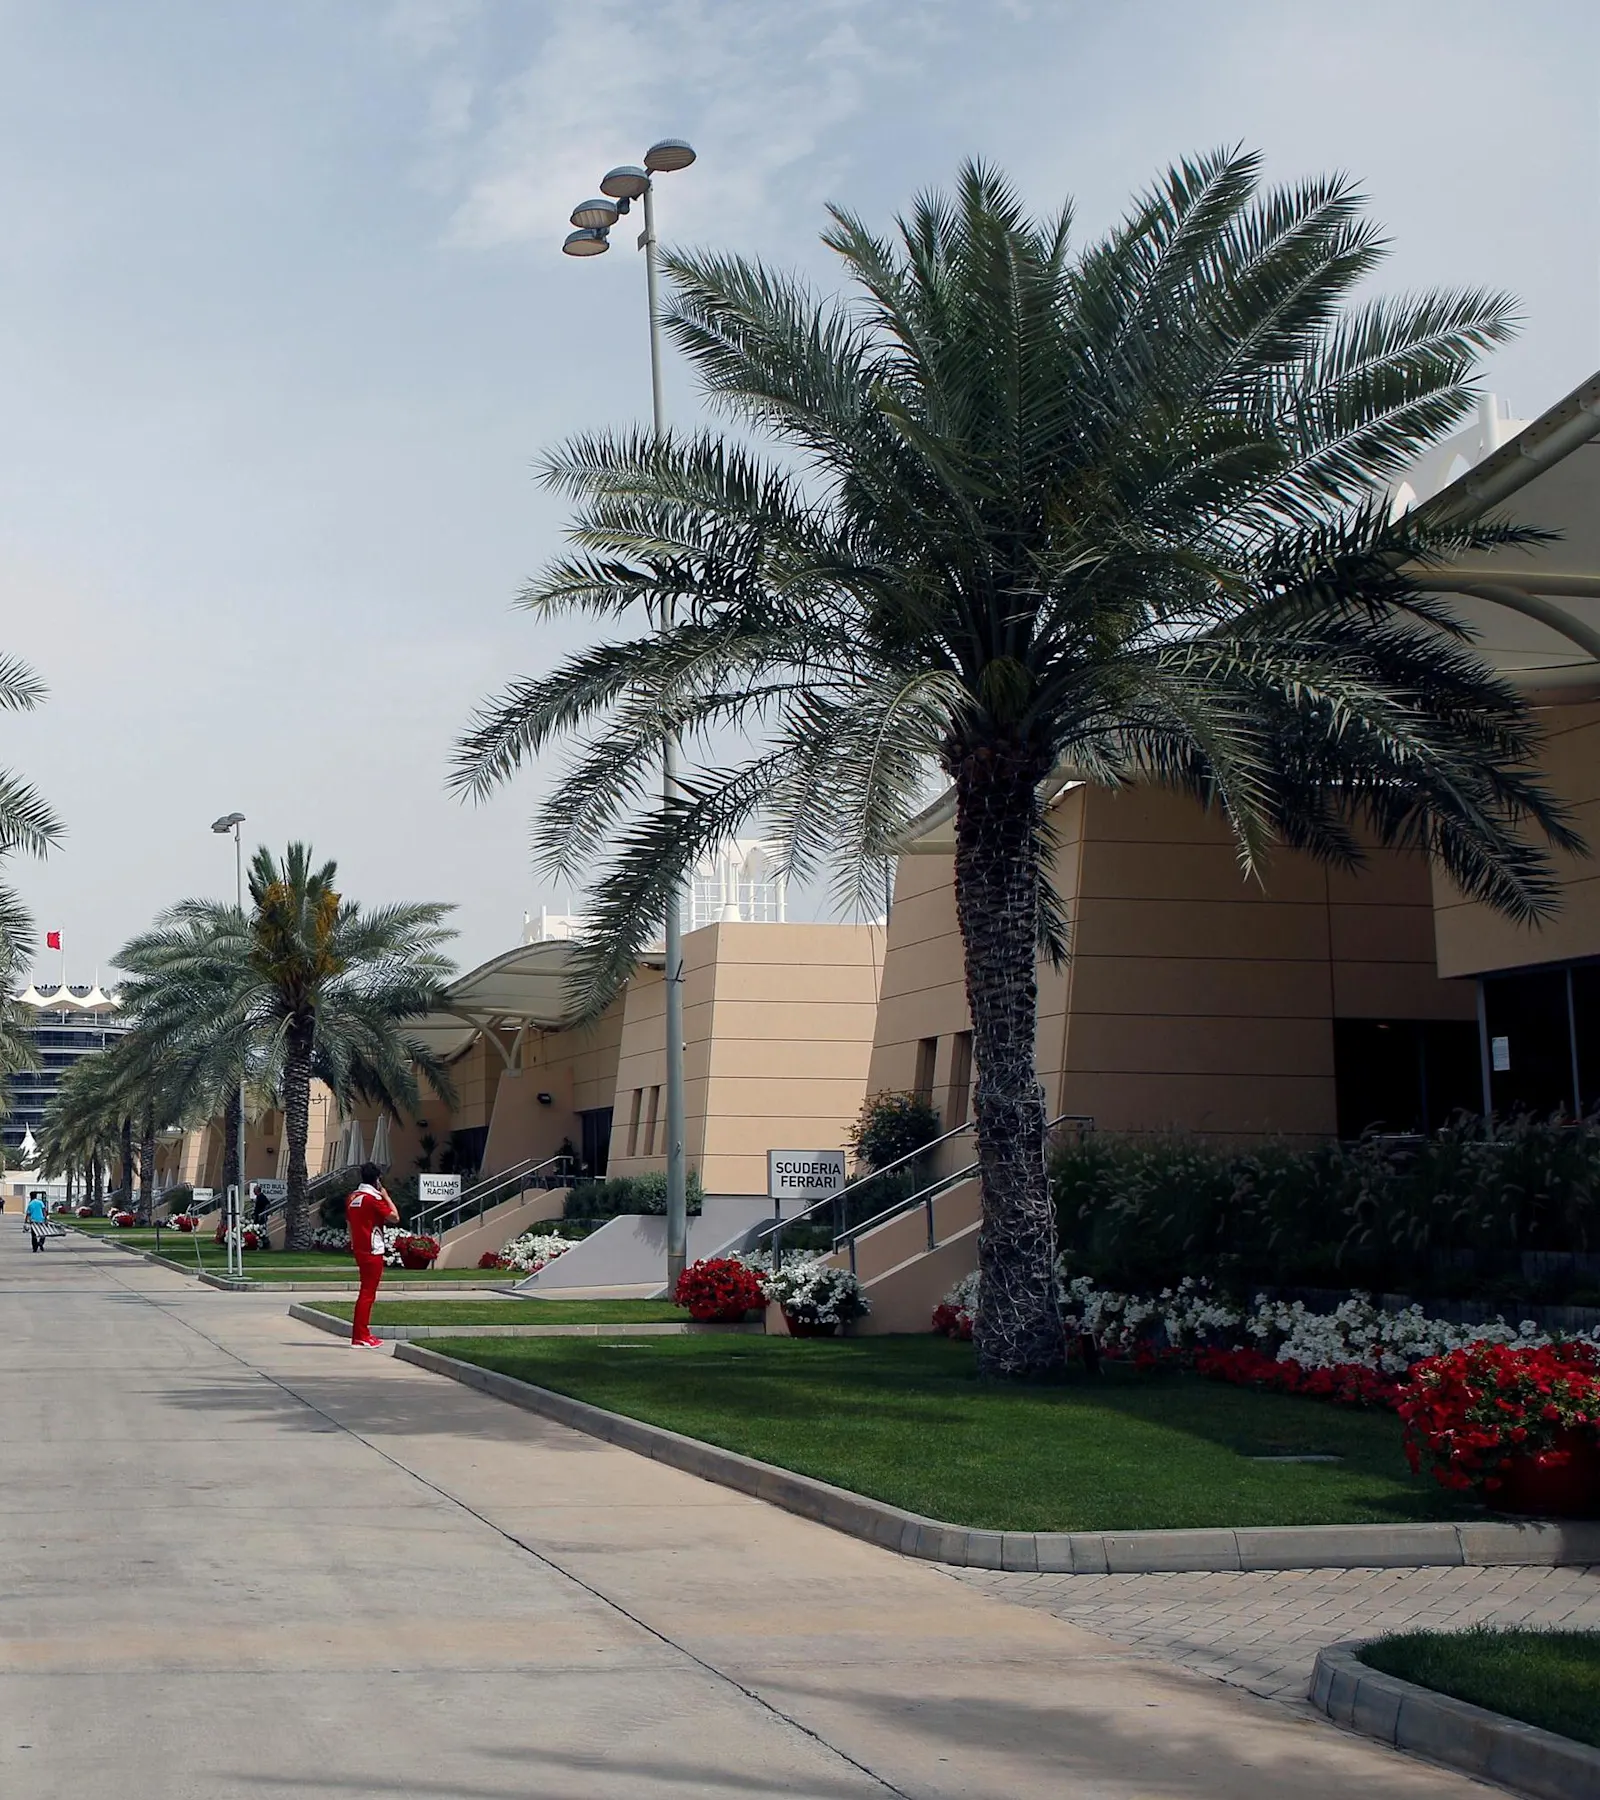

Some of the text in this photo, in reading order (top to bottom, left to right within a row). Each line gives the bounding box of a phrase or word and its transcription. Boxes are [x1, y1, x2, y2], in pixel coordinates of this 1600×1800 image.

[776, 1162, 841, 1175] SCUDERIA
[422, 1180, 459, 1188] WILLIAMS
[781, 1175, 836, 1188] FERRARI
